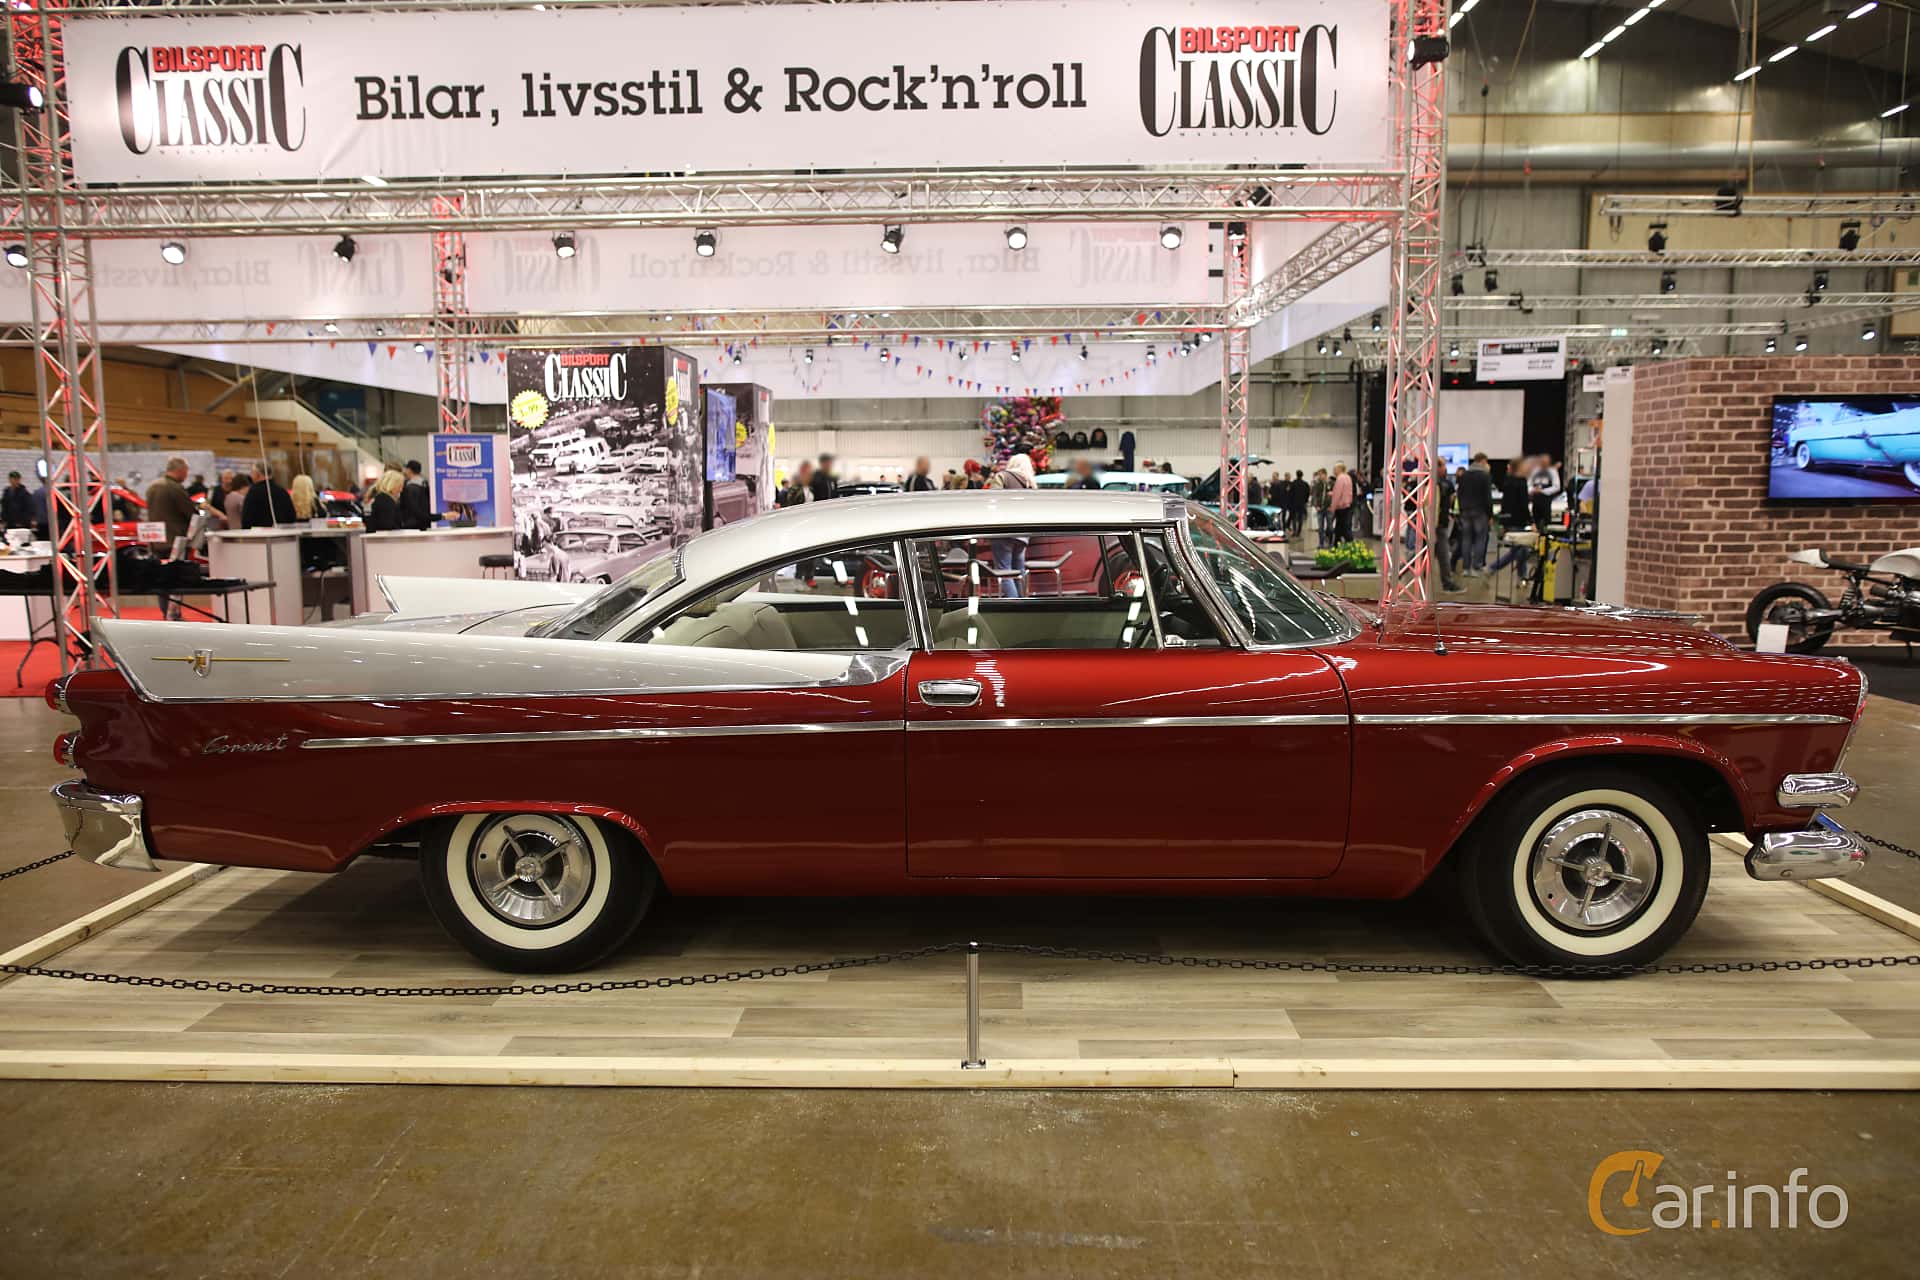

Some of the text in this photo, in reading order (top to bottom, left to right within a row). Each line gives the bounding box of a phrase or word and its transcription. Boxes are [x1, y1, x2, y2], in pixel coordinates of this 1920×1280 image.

[152, 45, 266, 72] BILSPORT
[1180, 26, 1300, 53] BILSPORT
[116, 43, 305, 155] CLASSIC
[355, 76, 499, 126] Bilar,
[521, 70, 703, 117] livsstil
[724, 67, 763, 113] &
[1139, 24, 1337, 137] CLASSIC
[544, 353, 628, 402] CLASSIC
[560, 353, 610, 367] BILSPORT
[200, 732, 289, 755] Coronet
